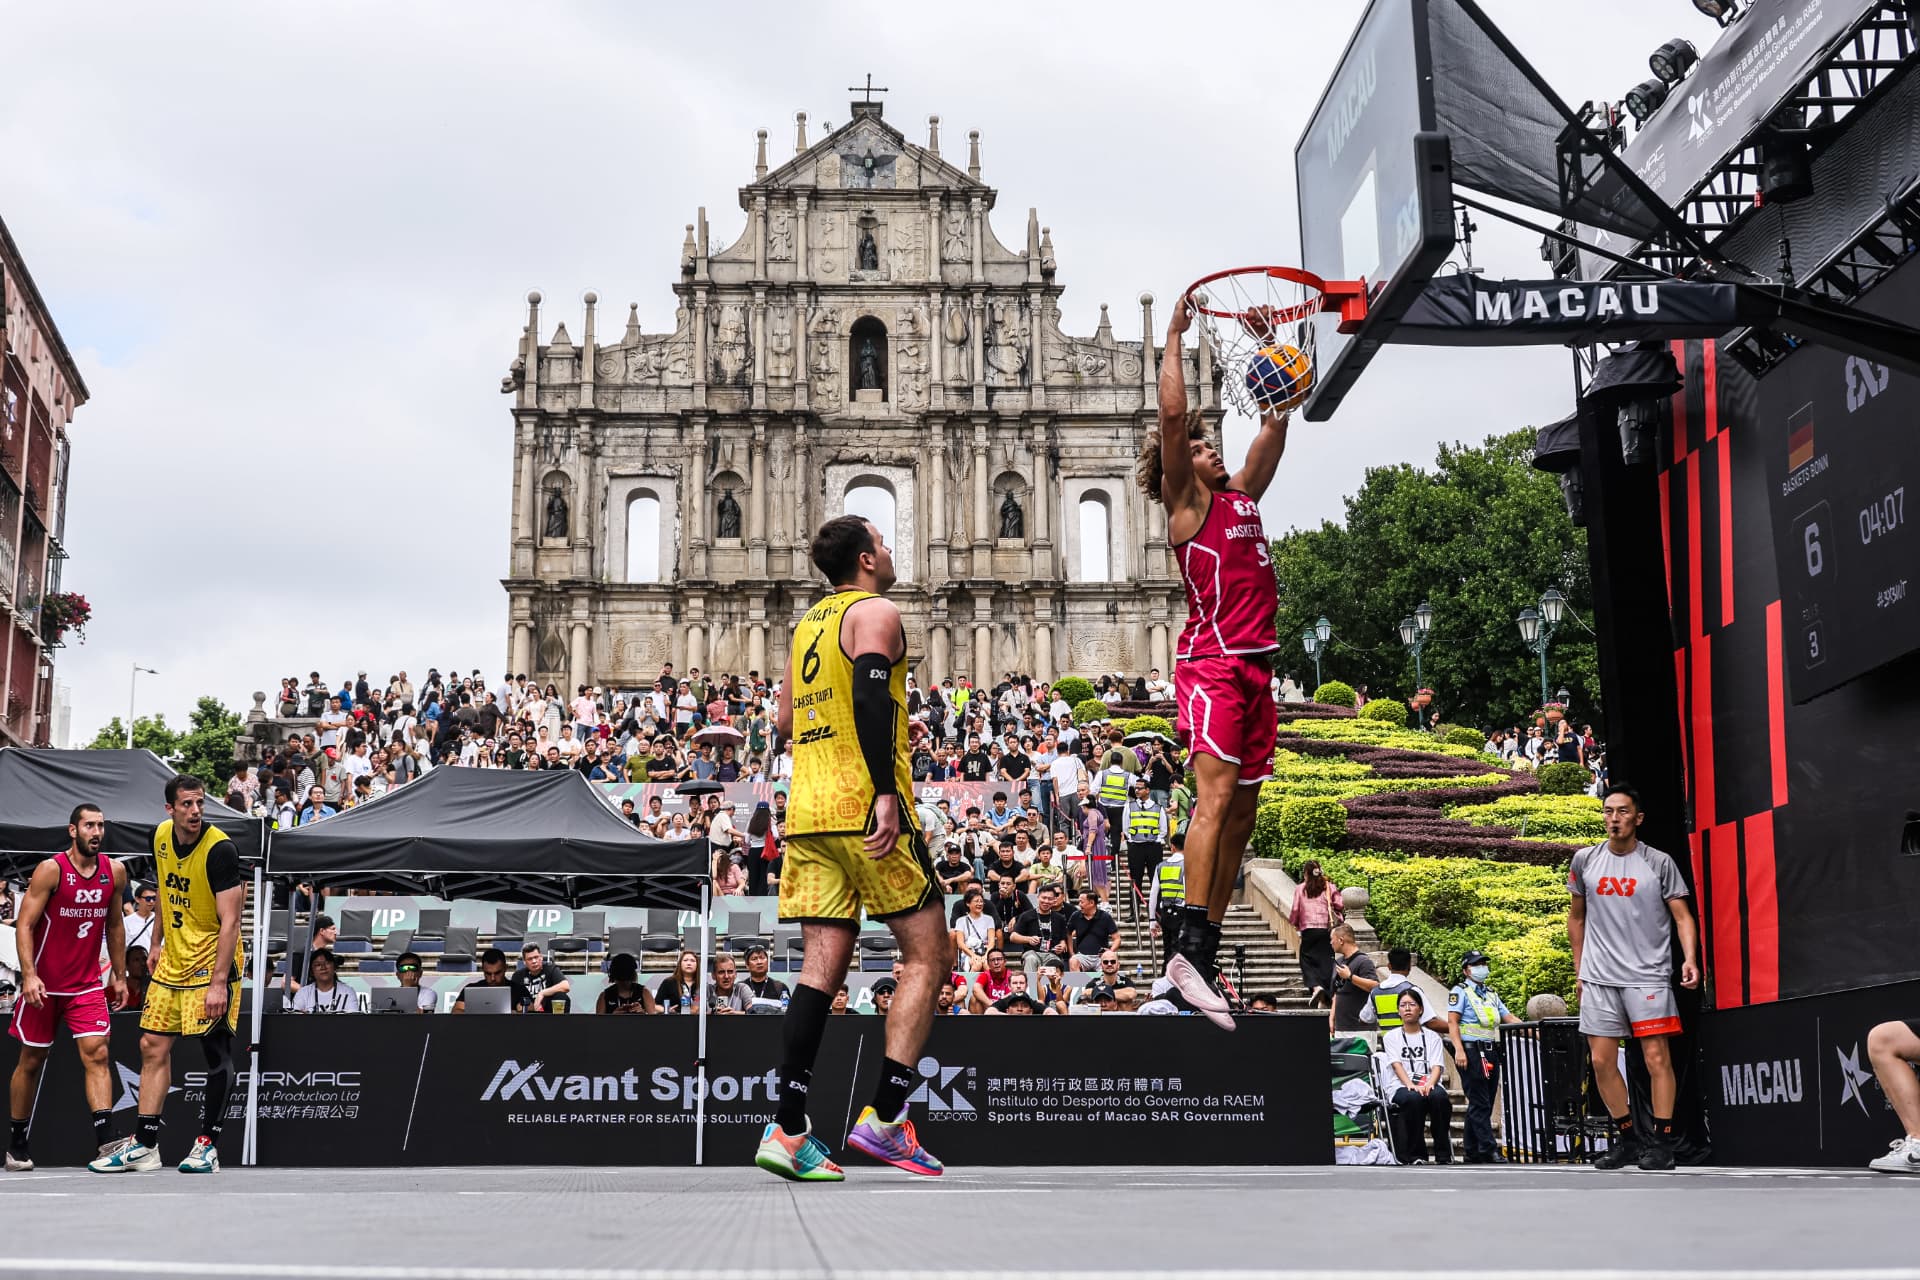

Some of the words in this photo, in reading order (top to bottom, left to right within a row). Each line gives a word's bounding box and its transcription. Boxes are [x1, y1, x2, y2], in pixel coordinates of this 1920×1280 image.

[1327, 48, 1377, 168] MACAU
[1475, 285, 1659, 321] MACAU
[1783, 466, 1810, 496] BASKETS
[1810, 453, 1829, 478] BONN
[1859, 487, 1904, 545] 04:07
[1804, 522, 1823, 576] 6
[801, 628, 824, 684] 6
[1809, 631, 1819, 658] 3
[60, 906, 92, 917] BASKETS
[94, 908, 109, 917] BON
[172, 911, 183, 928] 3
[77, 921, 93, 938] 8
[184, 1072, 361, 1087] SARMAC
[480, 1060, 639, 1101] Avant
[651, 1066, 782, 1109] Sport
[1721, 1058, 1803, 1106] MACAU
[273, 1091, 335, 1102] Production
[340, 1090, 360, 1102] Ltd
[988, 1094, 1038, 1106] Instituto
[1042, 1094, 1058, 1106] do
[1062, 1094, 1120, 1109] Desporto
[1124, 1094, 1140, 1106] do
[1144, 1094, 1199, 1106] Governo
[1203, 1094, 1219, 1106] da
[1223, 1095, 1264, 1106] RAEM
[508, 1114, 567, 1124] RELIABLE
[570, 1114, 626, 1124] PARTNER
[629, 1114, 653, 1124] FOR
[988, 1111, 1031, 1123] Sports
[1036, 1111, 1082, 1122] Bureau
[1087, 1111, 1100, 1122] of
[1105, 1111, 1147, 1122] Macao
[1151, 1111, 1179, 1122] SAR
[1184, 1111, 1264, 1122] Government
